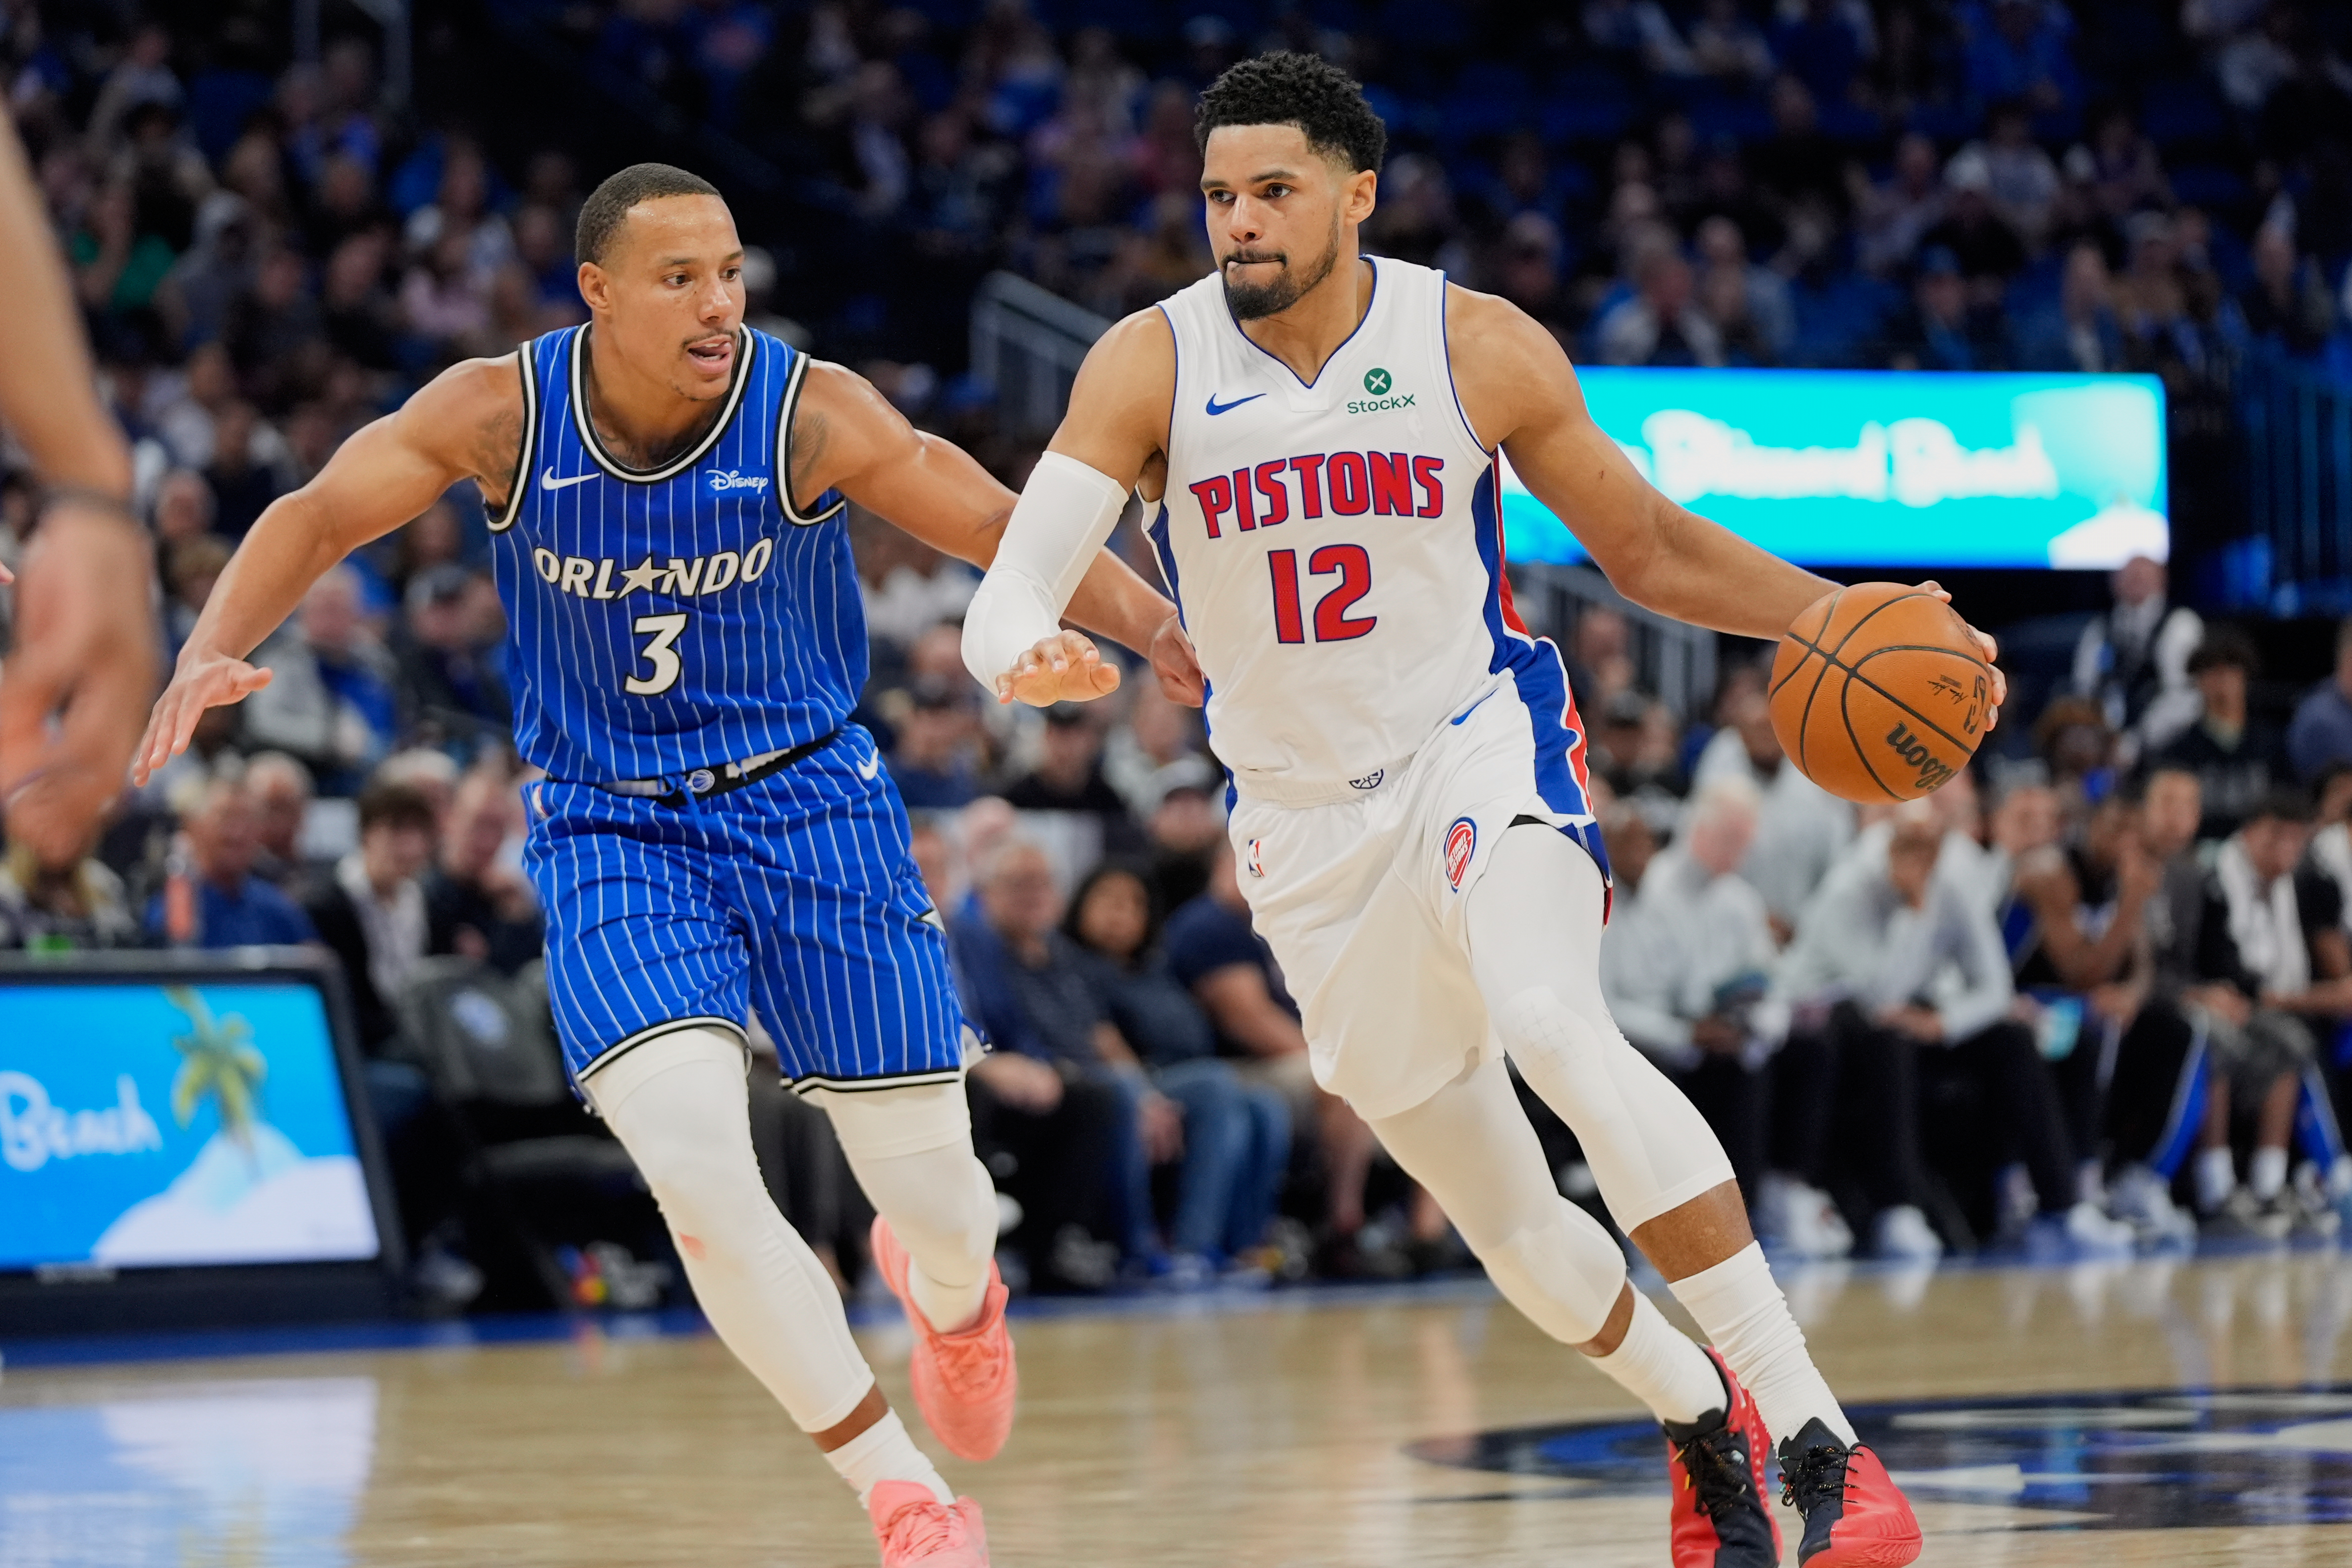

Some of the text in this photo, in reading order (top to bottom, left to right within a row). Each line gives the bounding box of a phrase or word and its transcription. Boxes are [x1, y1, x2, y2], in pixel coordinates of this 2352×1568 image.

[1347, 393, 1416, 414] StockX
[705, 469, 769, 495] Disney
[1189, 451, 1444, 539] PISTONS
[1268, 544, 1377, 644] 12
[624, 613, 688, 695] 3
[1885, 720, 1959, 793] ilson
